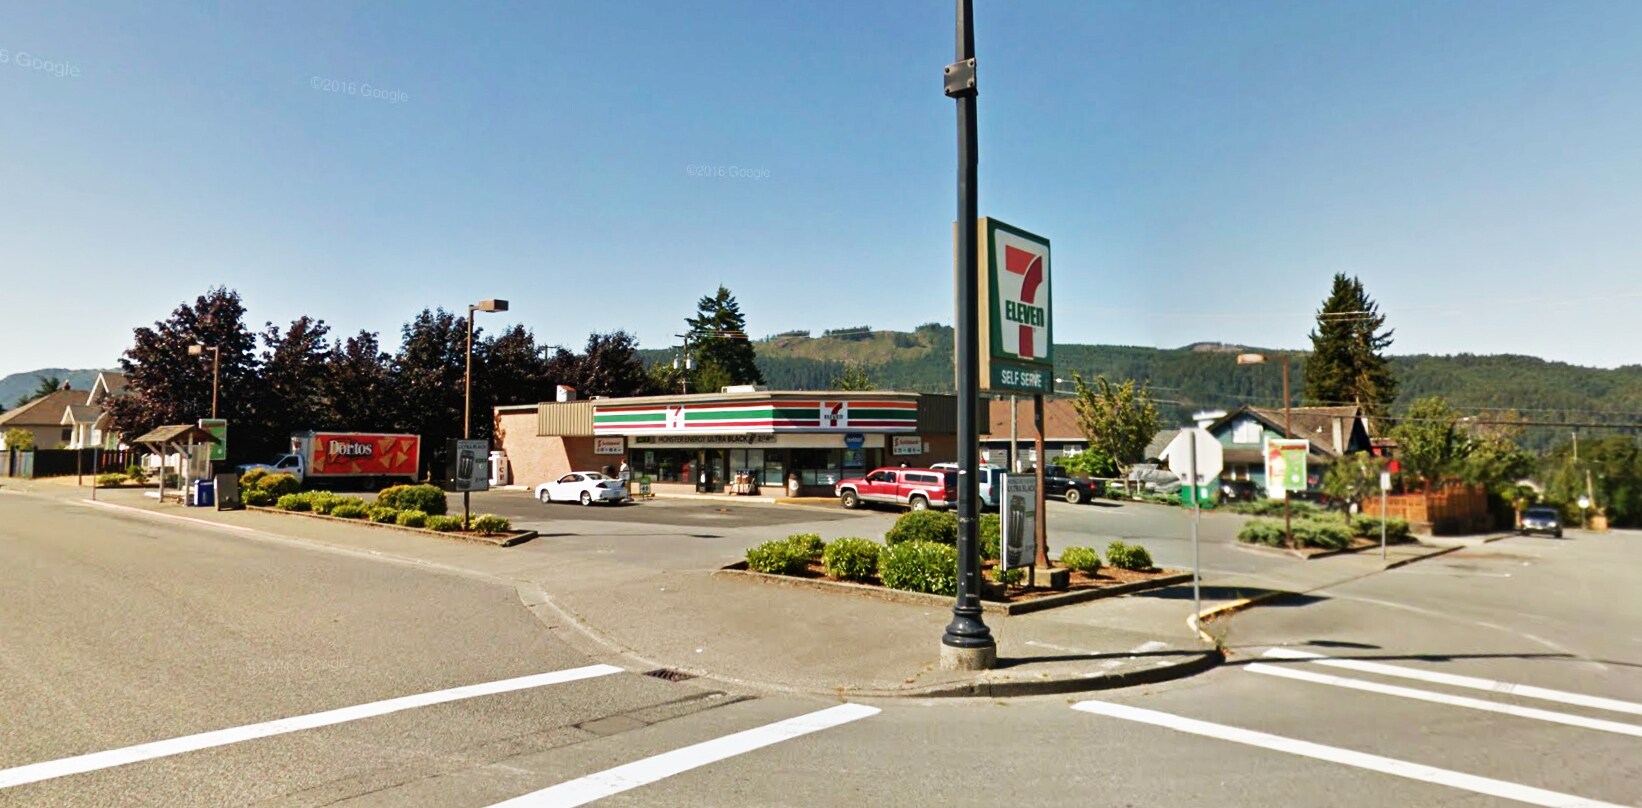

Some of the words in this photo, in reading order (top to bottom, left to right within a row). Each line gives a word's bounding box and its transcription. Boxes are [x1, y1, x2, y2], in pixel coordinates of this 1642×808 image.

[1005, 244, 1042, 358] 7
[1001, 369, 1020, 386] SELF
[1020, 372, 1043, 389] SERVE
[669, 405, 682, 428] 7
[824, 401, 844, 427] 7
[328, 440, 373, 456] Dortos
[707, 434, 726, 443] ULTRA
[727, 434, 747, 443] BLACK
